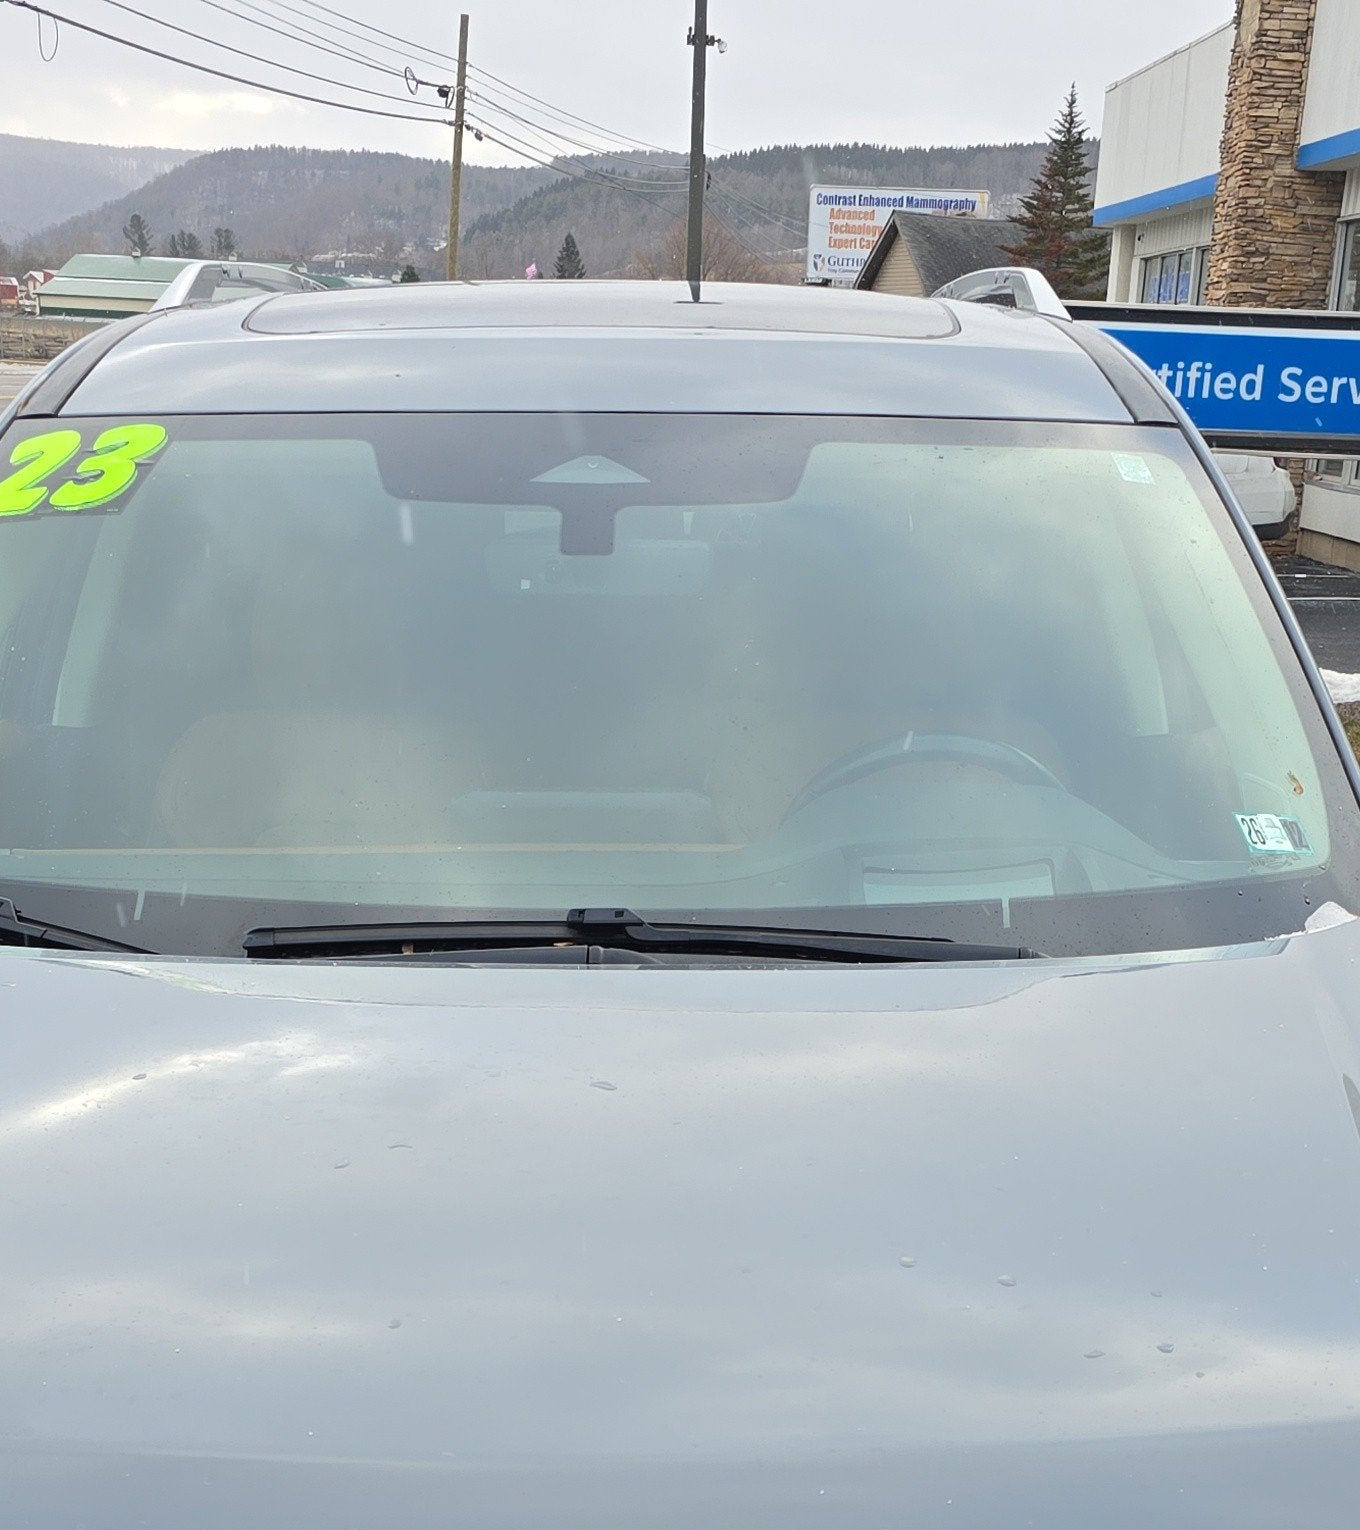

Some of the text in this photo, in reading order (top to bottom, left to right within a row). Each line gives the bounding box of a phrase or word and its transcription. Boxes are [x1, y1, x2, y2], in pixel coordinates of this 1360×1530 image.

[816, 193, 977, 214] Contrast Enhanced Mammography
[829, 208, 876, 221] Advanced
[828, 236, 857, 250] Expert
[1151, 361, 1265, 401] tified
[1241, 817, 1267, 846] 26
